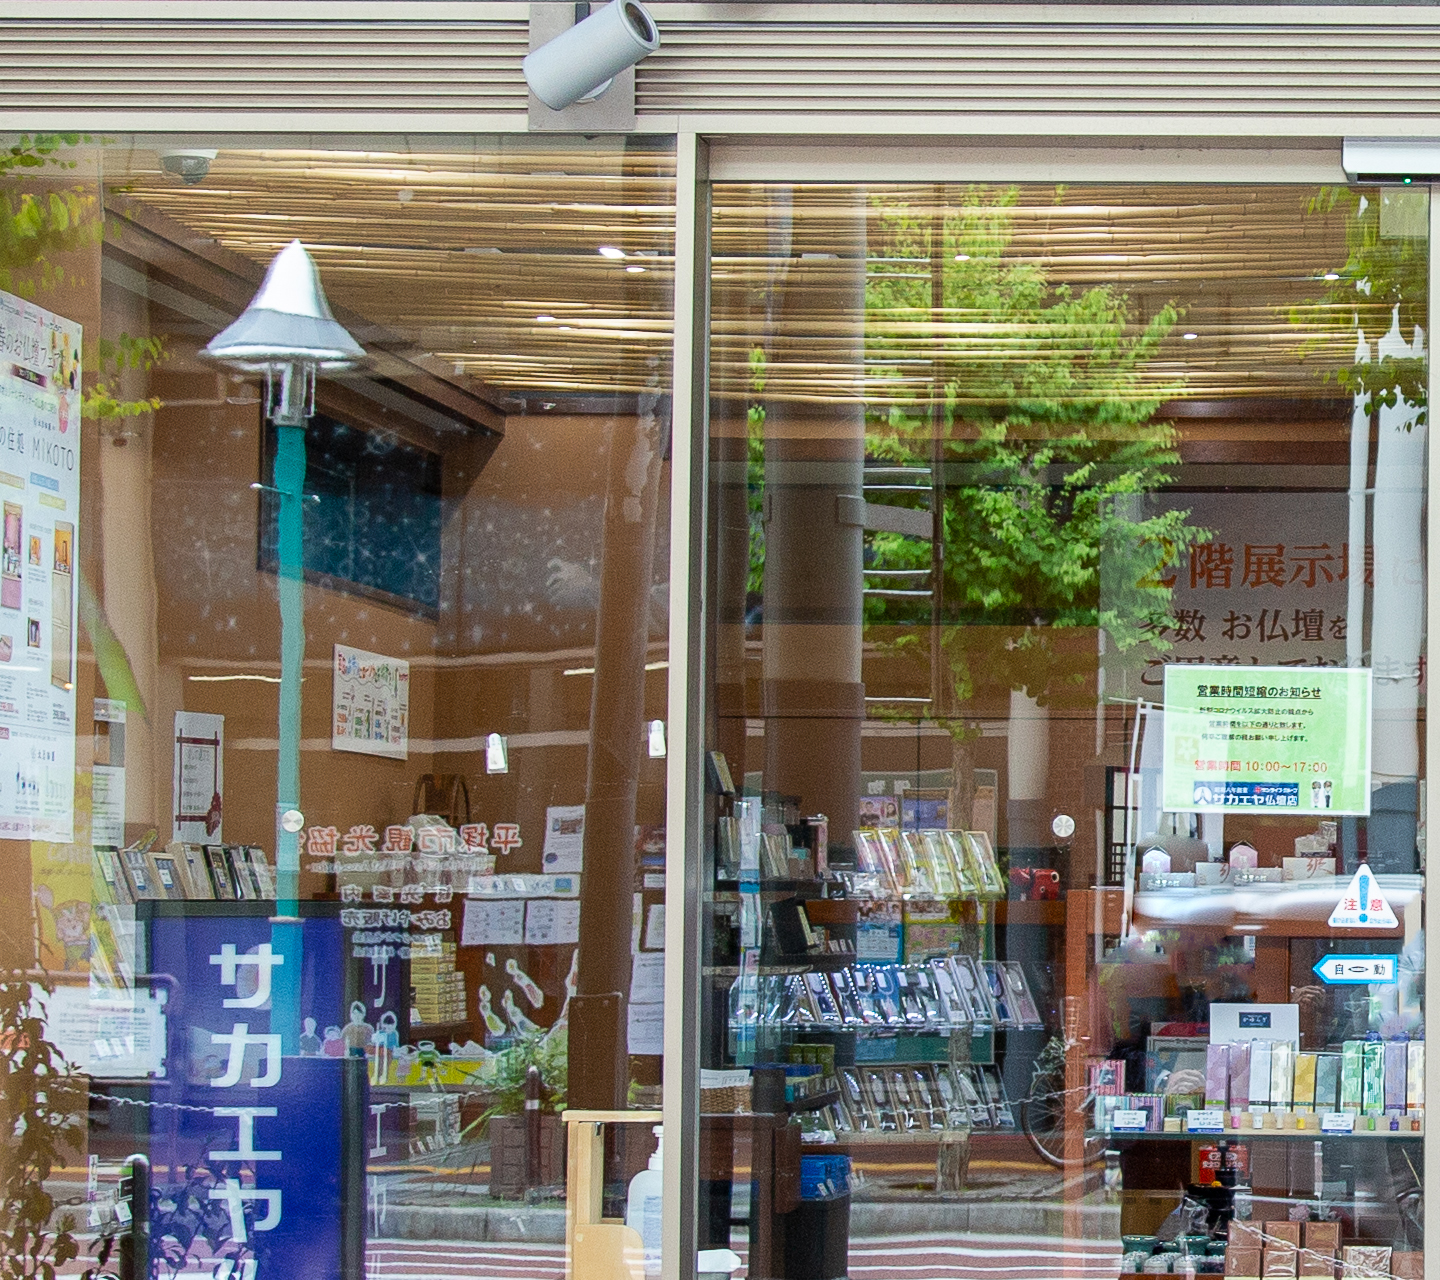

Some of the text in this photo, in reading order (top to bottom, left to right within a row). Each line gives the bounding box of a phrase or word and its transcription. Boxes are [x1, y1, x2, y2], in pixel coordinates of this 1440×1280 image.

[1197, 684, 1322, 698] 営業時間短縮のお知らせ
[1194, 760, 1241, 771] 営業時間
[1212, 794, 1298, 806] サカエヤ仏壇店
